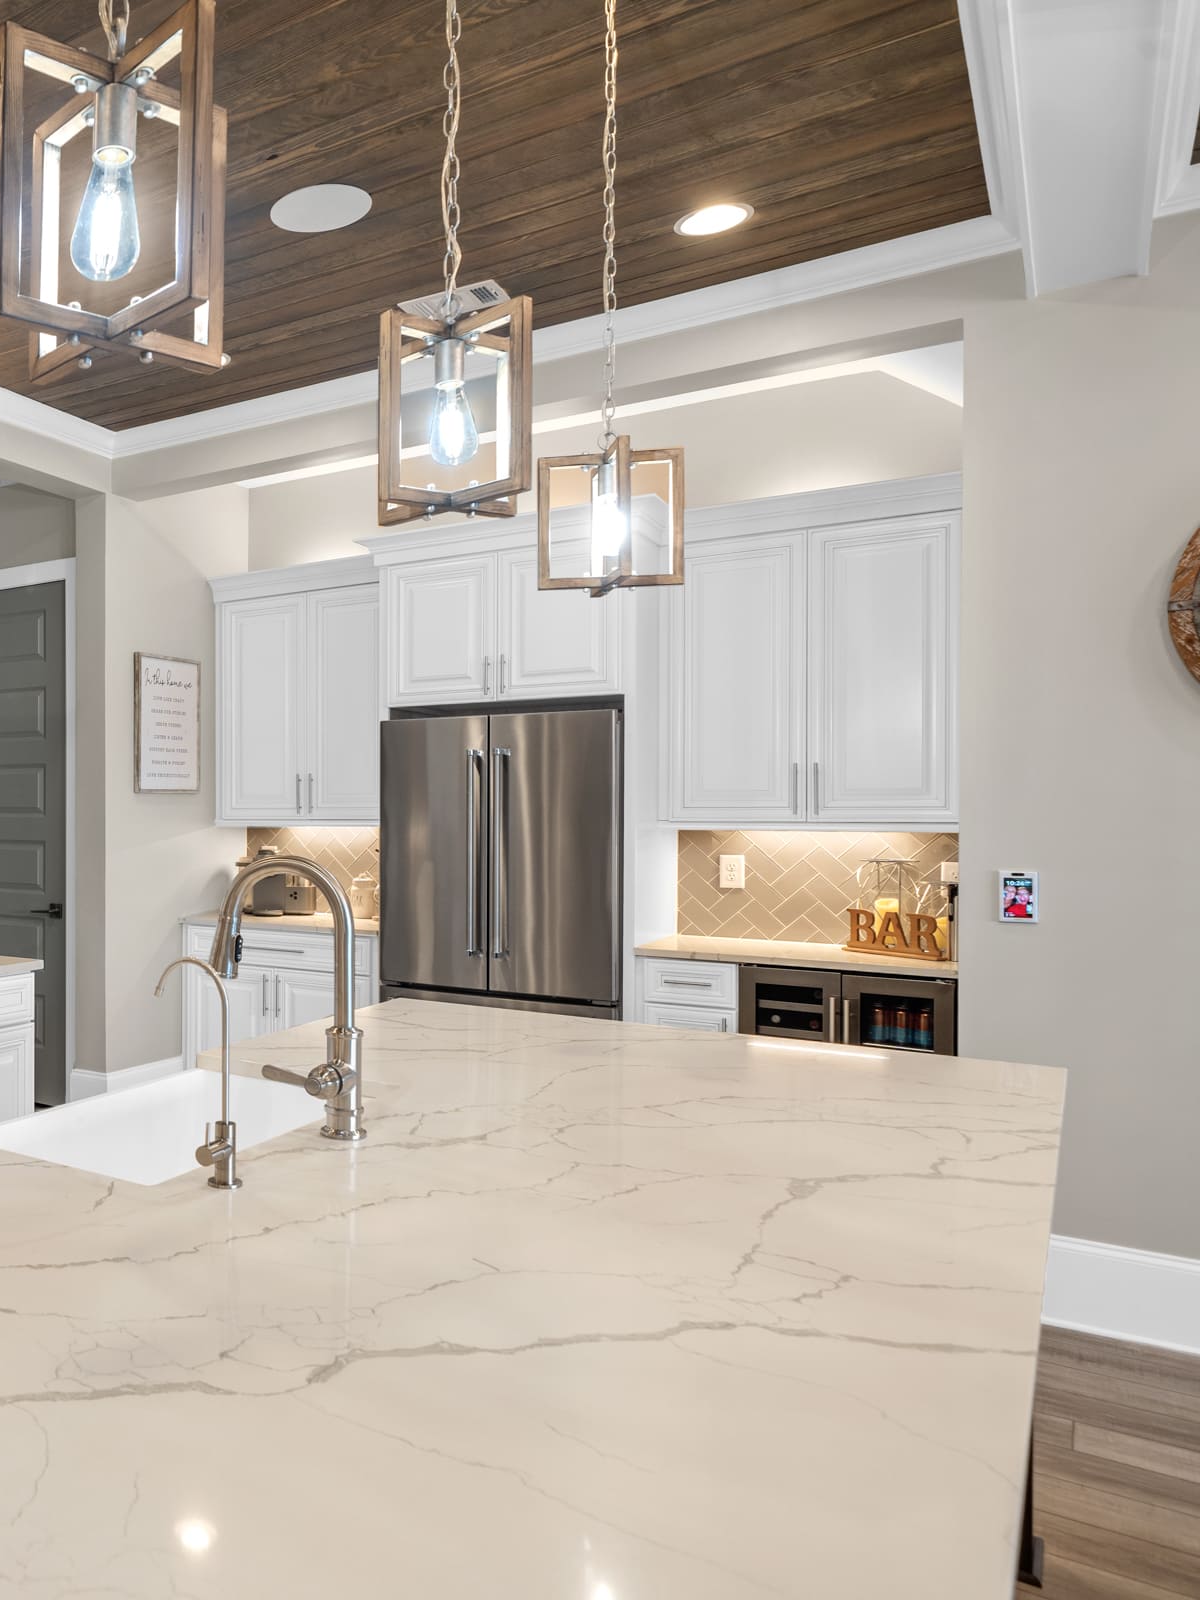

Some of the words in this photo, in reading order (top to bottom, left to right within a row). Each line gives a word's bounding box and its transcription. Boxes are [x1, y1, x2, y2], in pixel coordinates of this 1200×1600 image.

[152, 668, 165, 687] this
[166, 669, 184, 688] home
[846, 908, 941, 953] BAR
